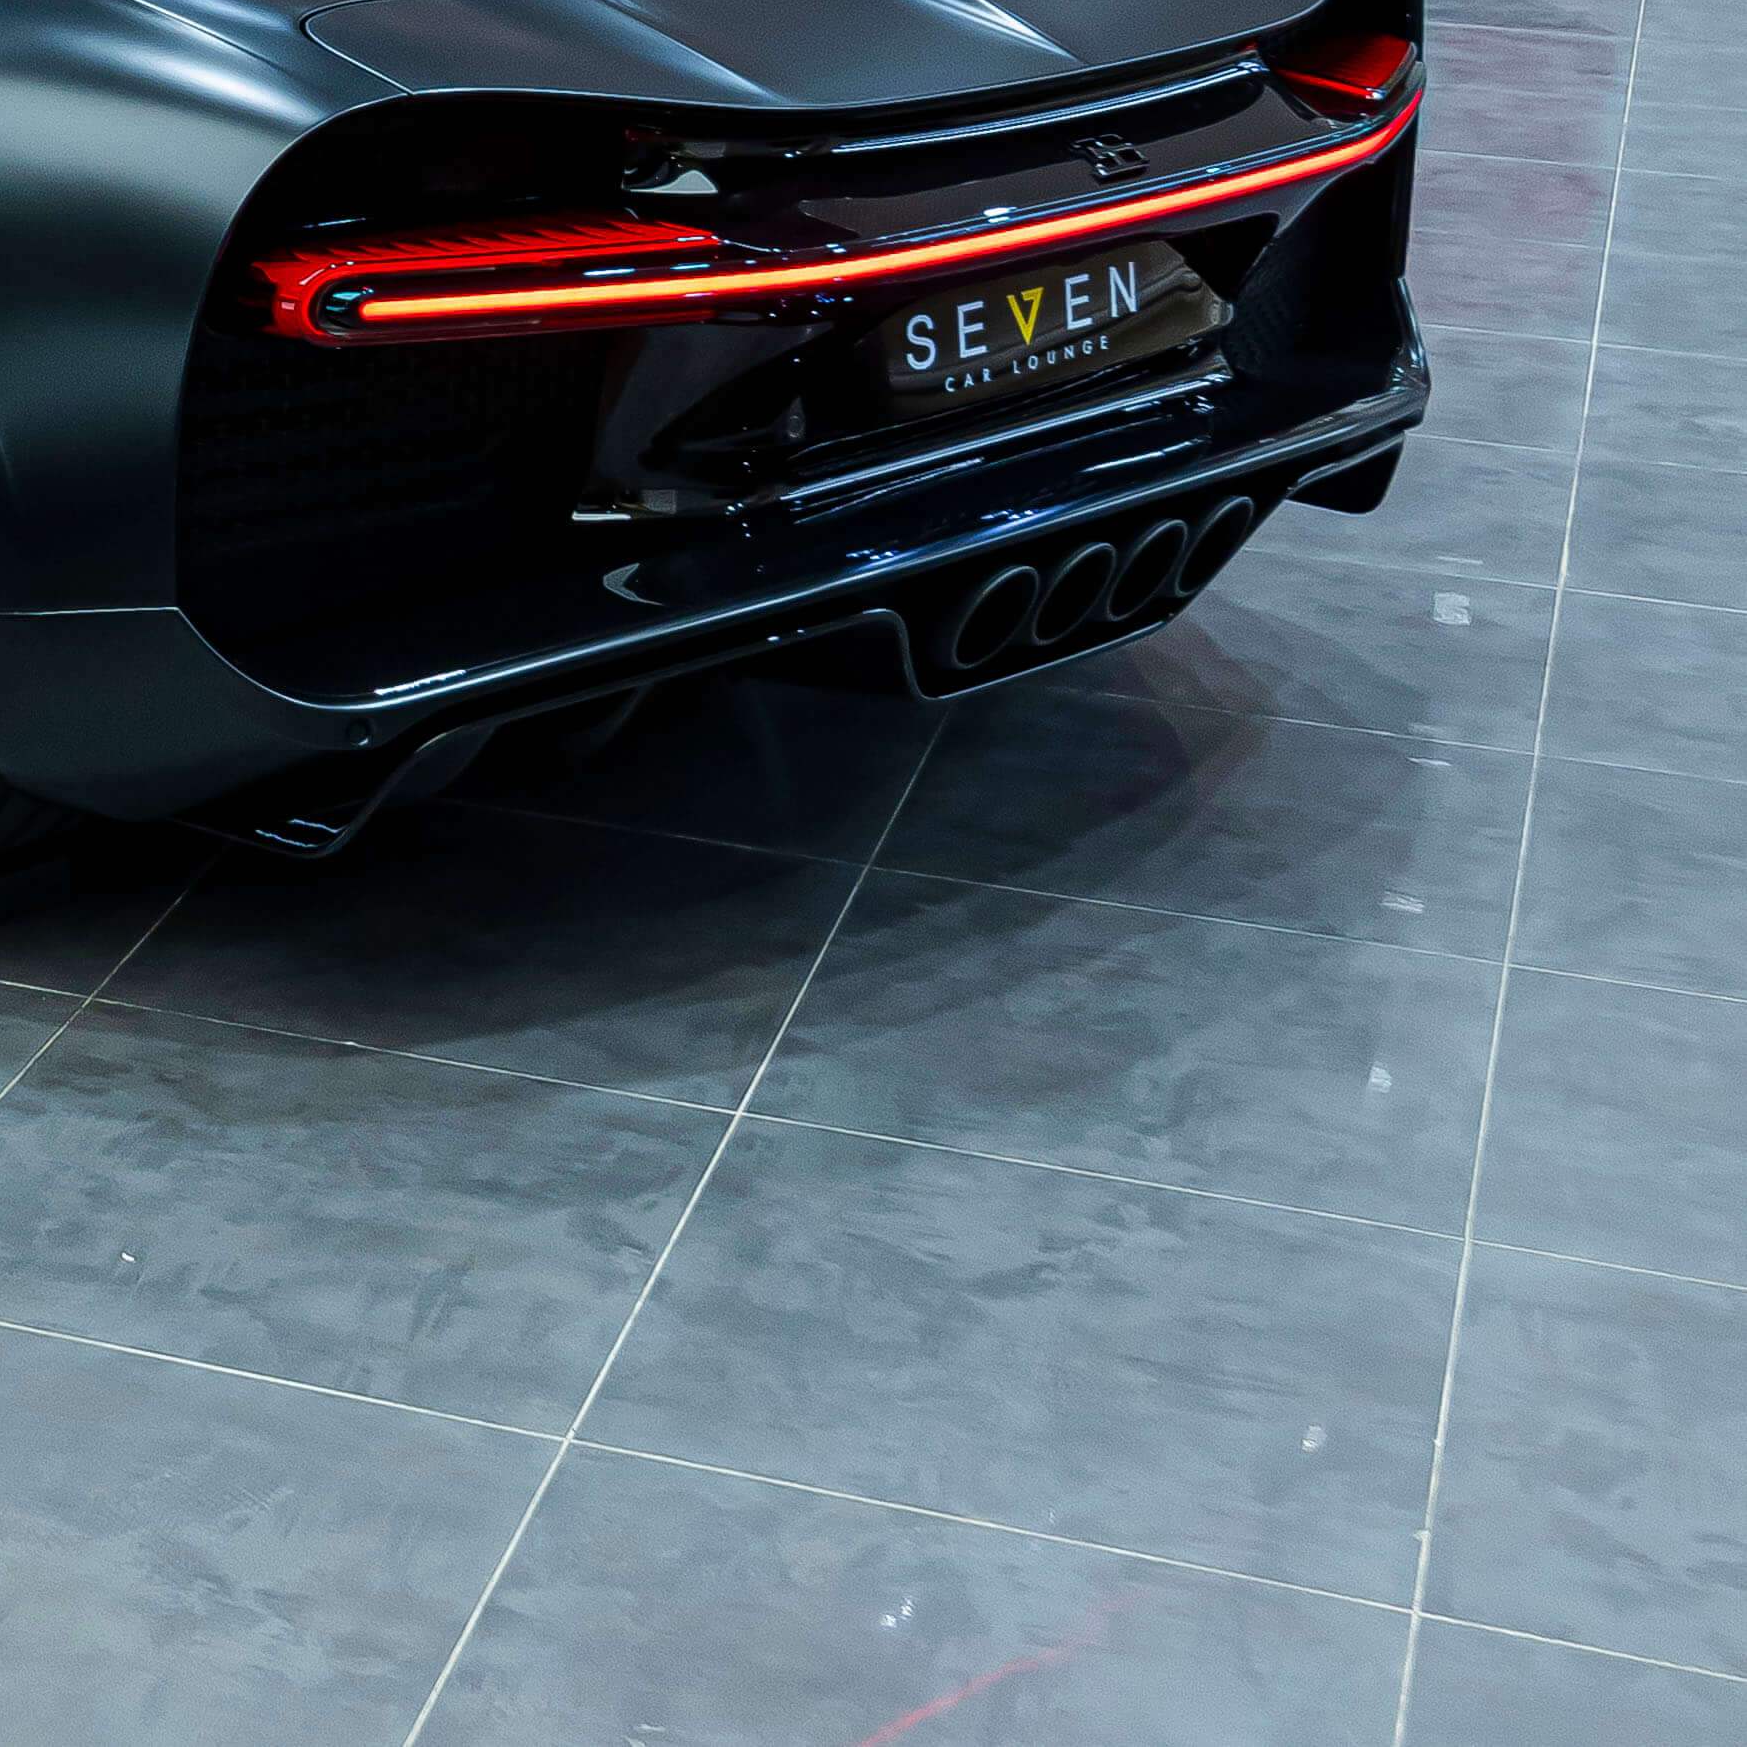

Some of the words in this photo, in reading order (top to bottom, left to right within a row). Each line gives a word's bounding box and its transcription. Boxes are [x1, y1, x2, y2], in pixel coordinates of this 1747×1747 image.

[905, 261, 1138, 371] SEVEN
[944, 368, 992, 393] CAR
[1012, 334, 1111, 375] LOUNGE
